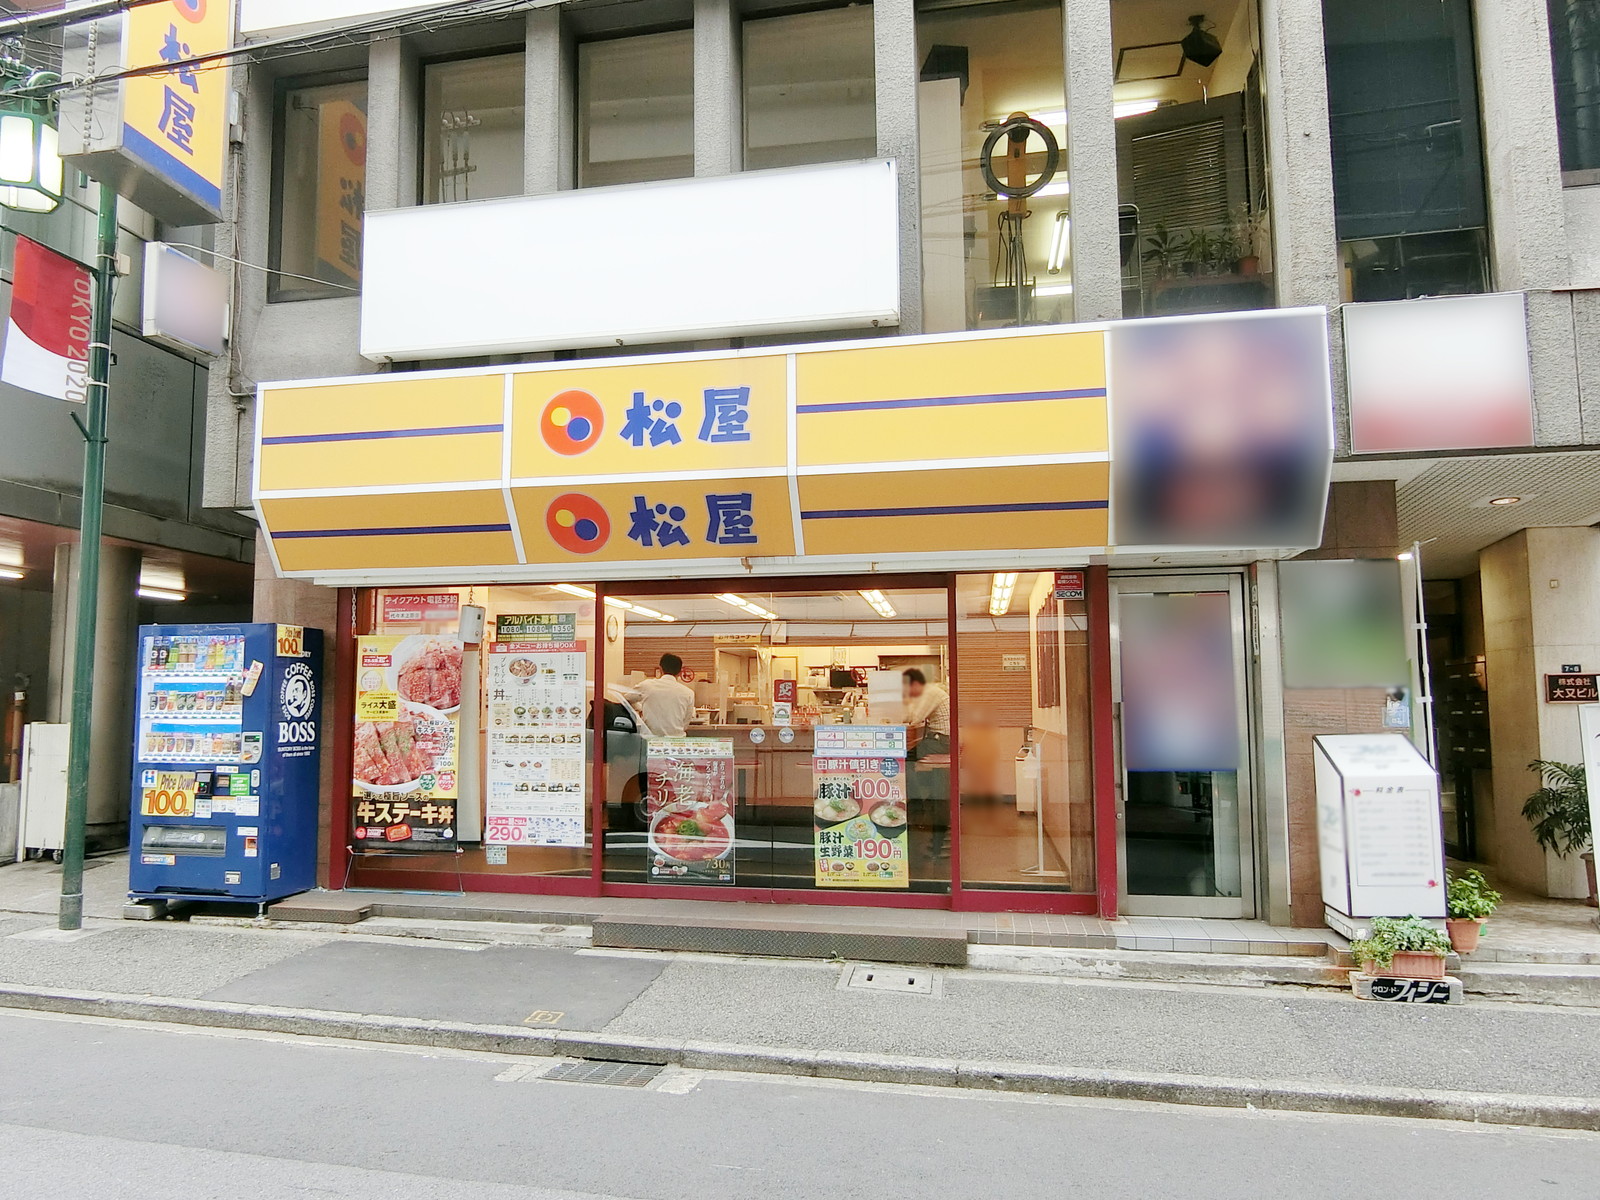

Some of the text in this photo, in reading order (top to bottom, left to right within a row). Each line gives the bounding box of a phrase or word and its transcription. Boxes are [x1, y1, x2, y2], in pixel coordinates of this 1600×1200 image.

[158, 23, 200, 156] 松屋
[65, 266, 91, 403] TOKYO 2020
[620, 386, 751, 447] 松屋
[627, 492, 758, 547] 松屋
[285, 662, 313, 681] COFFEE
[1558, 678, 1591, 686] 株式会社
[1552, 688, 1598, 699] 大又ビル
[278, 721, 316, 743] BOSS
[160, 774, 176, 790] Price
[656, 761, 696, 807] 海老 チリ
[819, 783, 851, 799] 豚汁
[357, 802, 454, 824] 牛ステーキ丼
[820, 832, 844, 844] 豚汁
[820, 845, 854, 858] 生野菜
